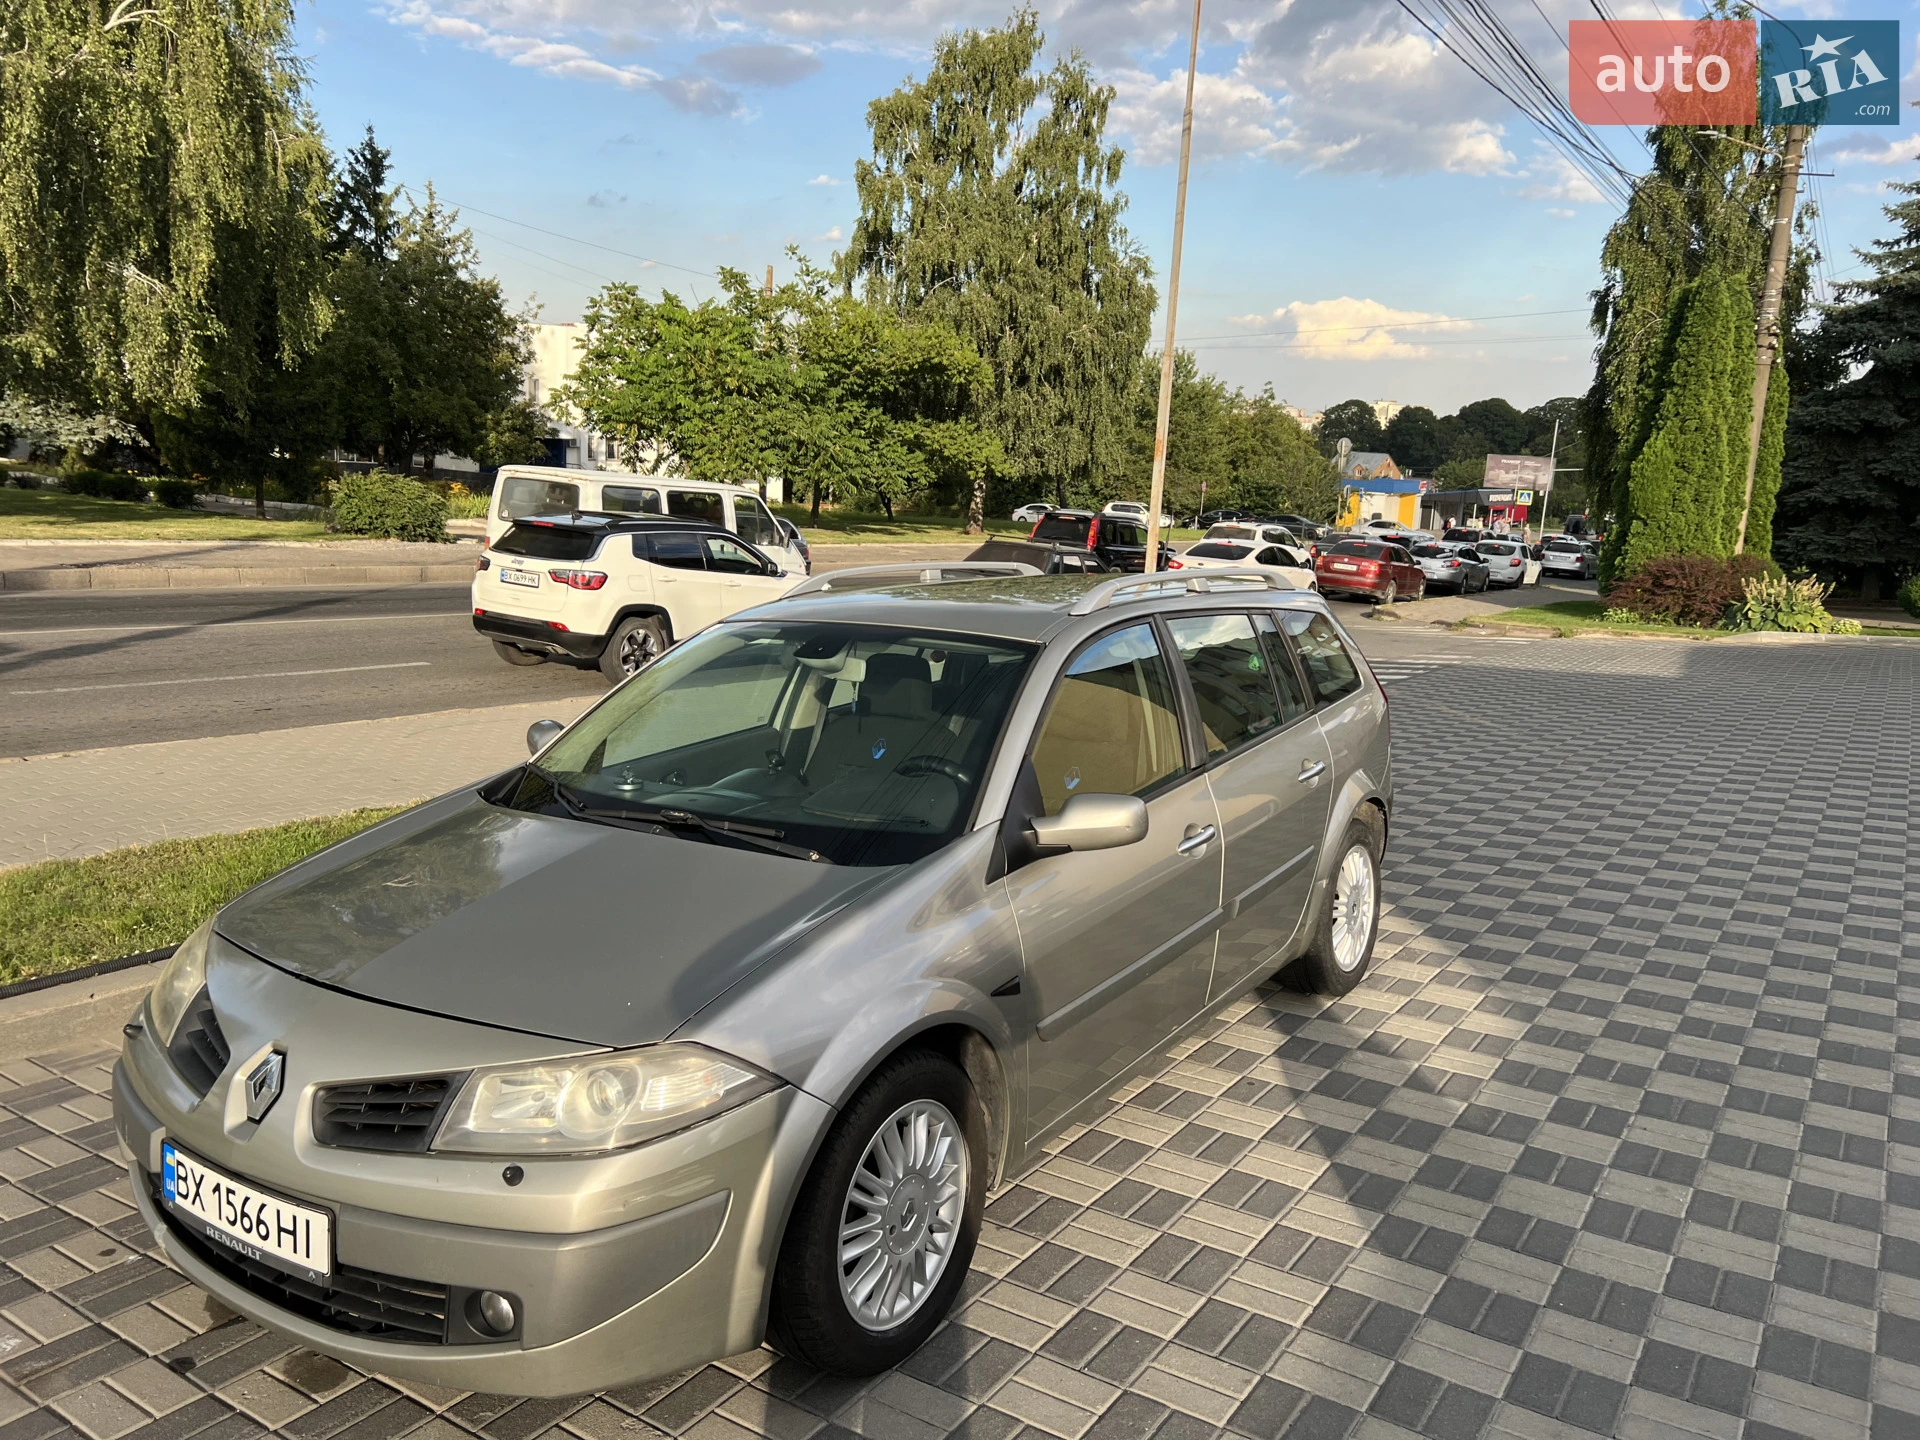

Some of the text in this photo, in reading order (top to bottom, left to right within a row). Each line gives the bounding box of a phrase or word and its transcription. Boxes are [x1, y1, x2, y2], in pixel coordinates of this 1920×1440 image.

[504, 572, 512, 580] BX
[528, 576, 536, 584] HK
[166, 1178, 175, 1193] UA
[176, 1159, 310, 1259] BX 1566 HI
[206, 1226, 262, 1261] RENAULT
